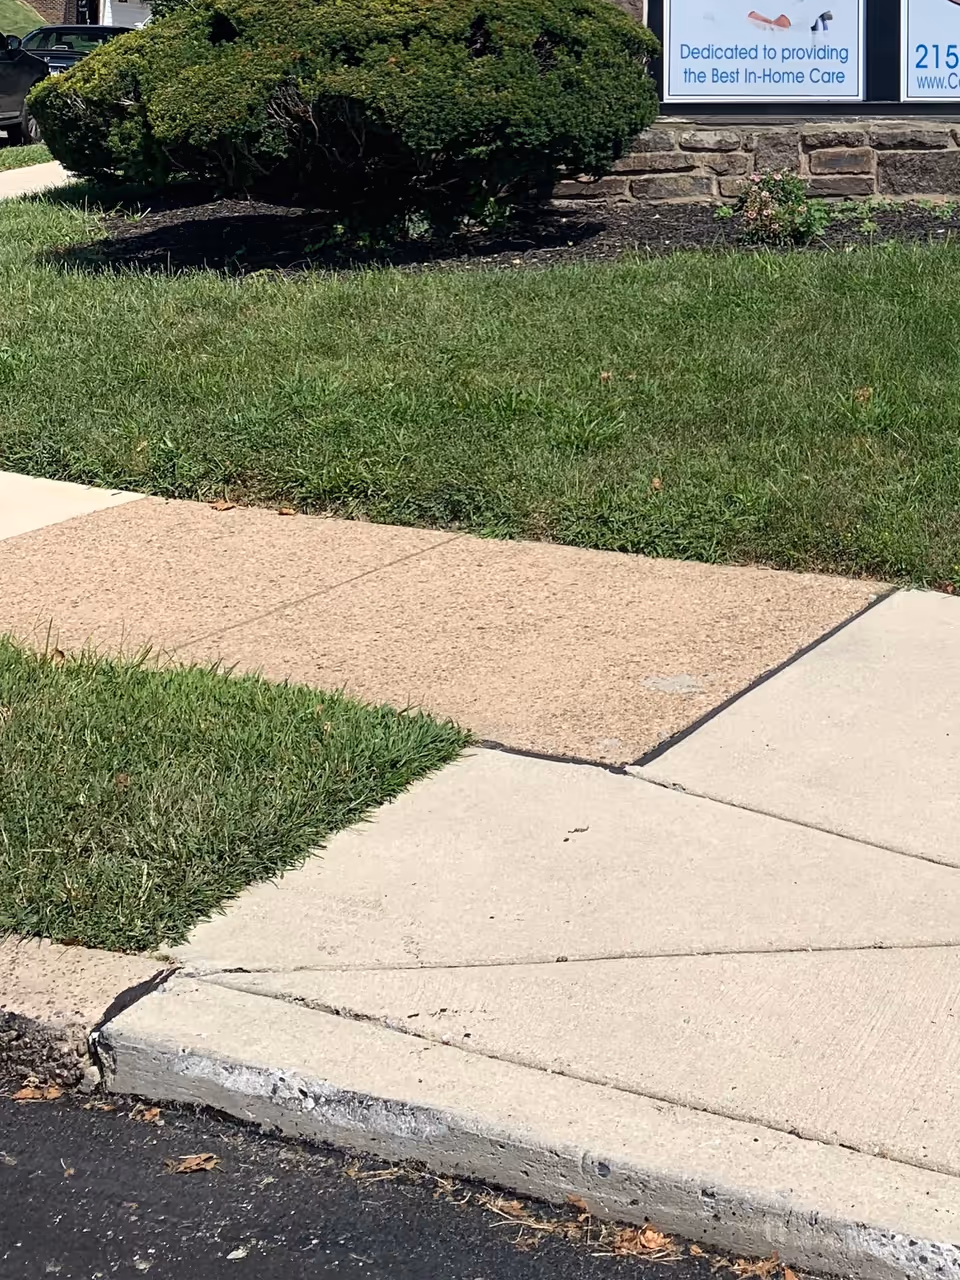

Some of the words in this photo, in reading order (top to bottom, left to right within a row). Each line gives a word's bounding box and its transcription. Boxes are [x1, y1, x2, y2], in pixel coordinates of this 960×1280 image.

[680, 44, 758, 60] Dedicated
[763, 45, 776, 60] to
[782, 45, 848, 63] providing
[684, 68, 706, 83] the
[712, 68, 739, 83] Best
[744, 68, 804, 83] In-Home
[810, 68, 845, 83] Care
